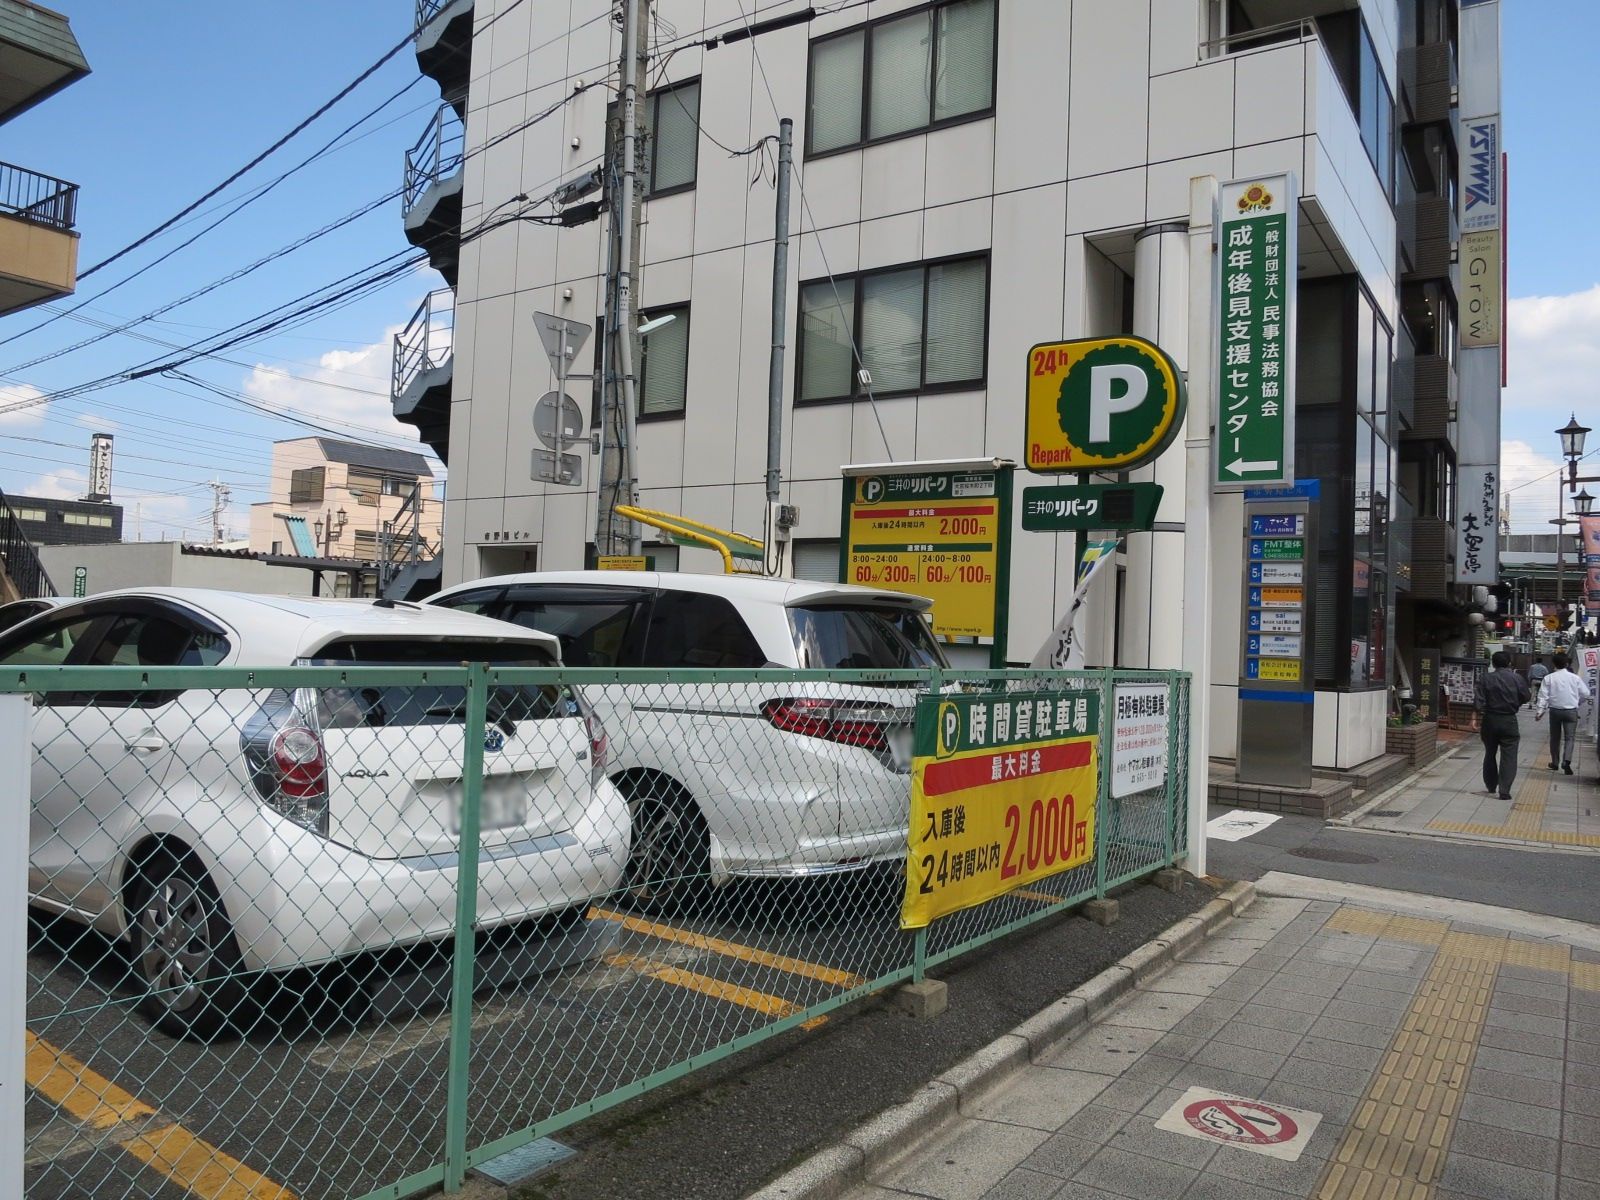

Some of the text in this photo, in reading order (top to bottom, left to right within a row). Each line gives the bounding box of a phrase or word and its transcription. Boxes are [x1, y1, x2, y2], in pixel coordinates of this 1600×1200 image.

[1465, 124, 1489, 212] YAMASA
[1466, 235, 1494, 244] Beauty
[1469, 245, 1491, 253] Salon
[1469, 257, 1487, 339] Grow
[1261, 220, 1280, 417] 一般財団法人 民事法務協会
[1225, 225, 1254, 453] 成年後見支援センター
[1034, 349, 1068, 376] 24h
[1088, 363, 1149, 444] P
[1031, 444, 1072, 466] Repark
[887, 476, 947, 493] 三井のリパーク
[1028, 498, 1098, 517] 三井のリパーク
[939, 517, 986, 536] 2,000円
[968, 697, 1089, 745] 時間貸駐車場
[1117, 694, 1165, 720] 月極有料駐車場
[346, 769, 389, 779] AQUA
[990, 750, 1041, 781] 最大料金
[922, 804, 966, 843] 入庫後
[919, 794, 1087, 895] 24時間以内 2,000円
